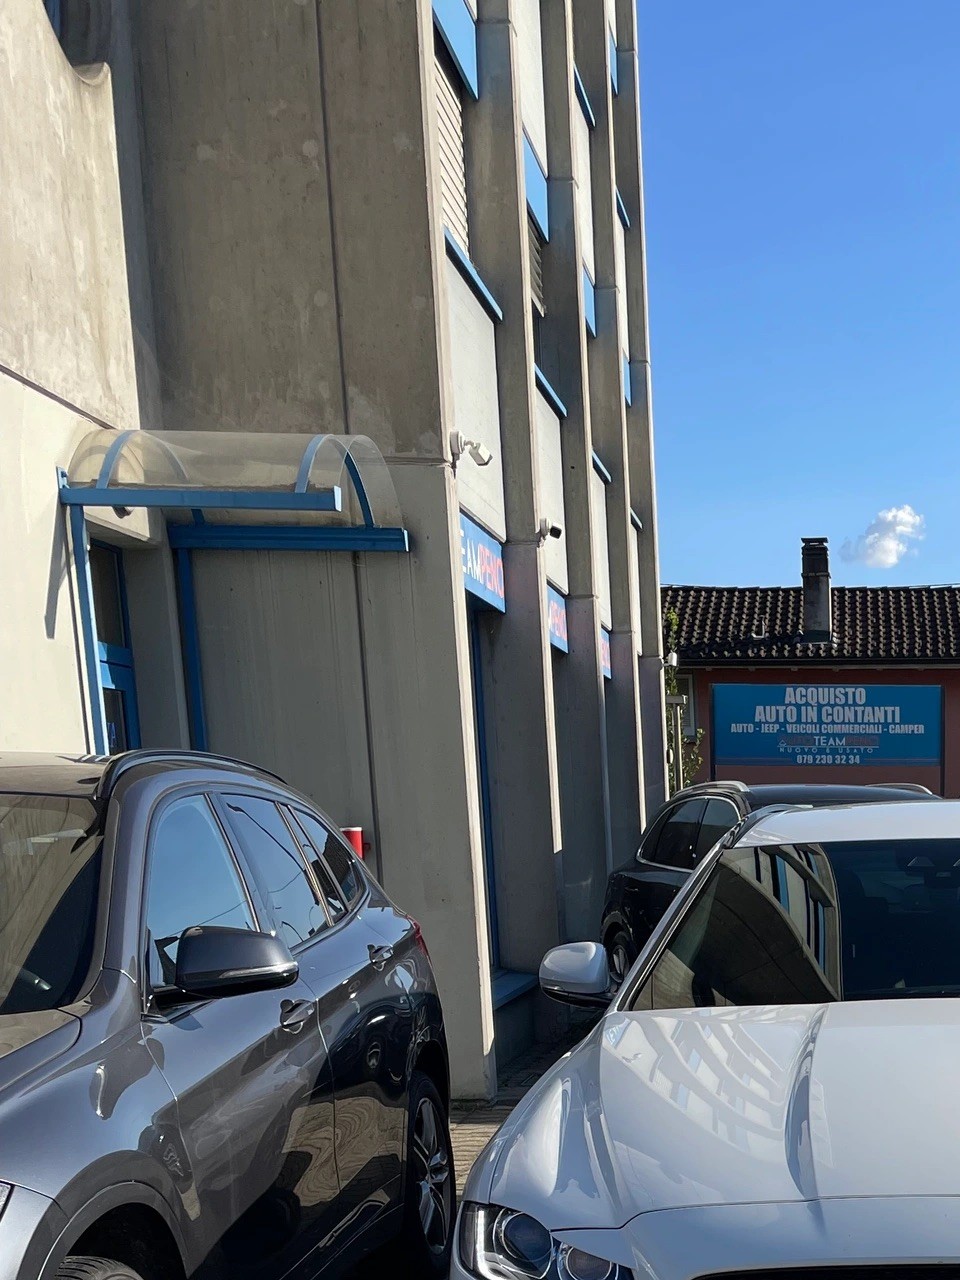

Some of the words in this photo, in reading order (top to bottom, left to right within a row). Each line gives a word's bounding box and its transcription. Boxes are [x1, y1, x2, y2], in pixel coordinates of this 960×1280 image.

[785, 687, 866, 705] ACQUISTO
[755, 705, 797, 722] AUTO
[801, 706, 817, 722] IN
[821, 706, 900, 723] CONTANTI
[731, 723, 754, 733] AUTO
[761, 724, 779, 733] JEEP
[786, 724, 819, 733] VEICOLI
[821, 724, 882, 734] COMMERCIALI
[889, 724, 924, 734] CAMPER
[796, 755, 813, 764] 079
[815, 755, 833, 764] 230
[835, 755, 846, 764] 32
[848, 755, 860, 764] 34
